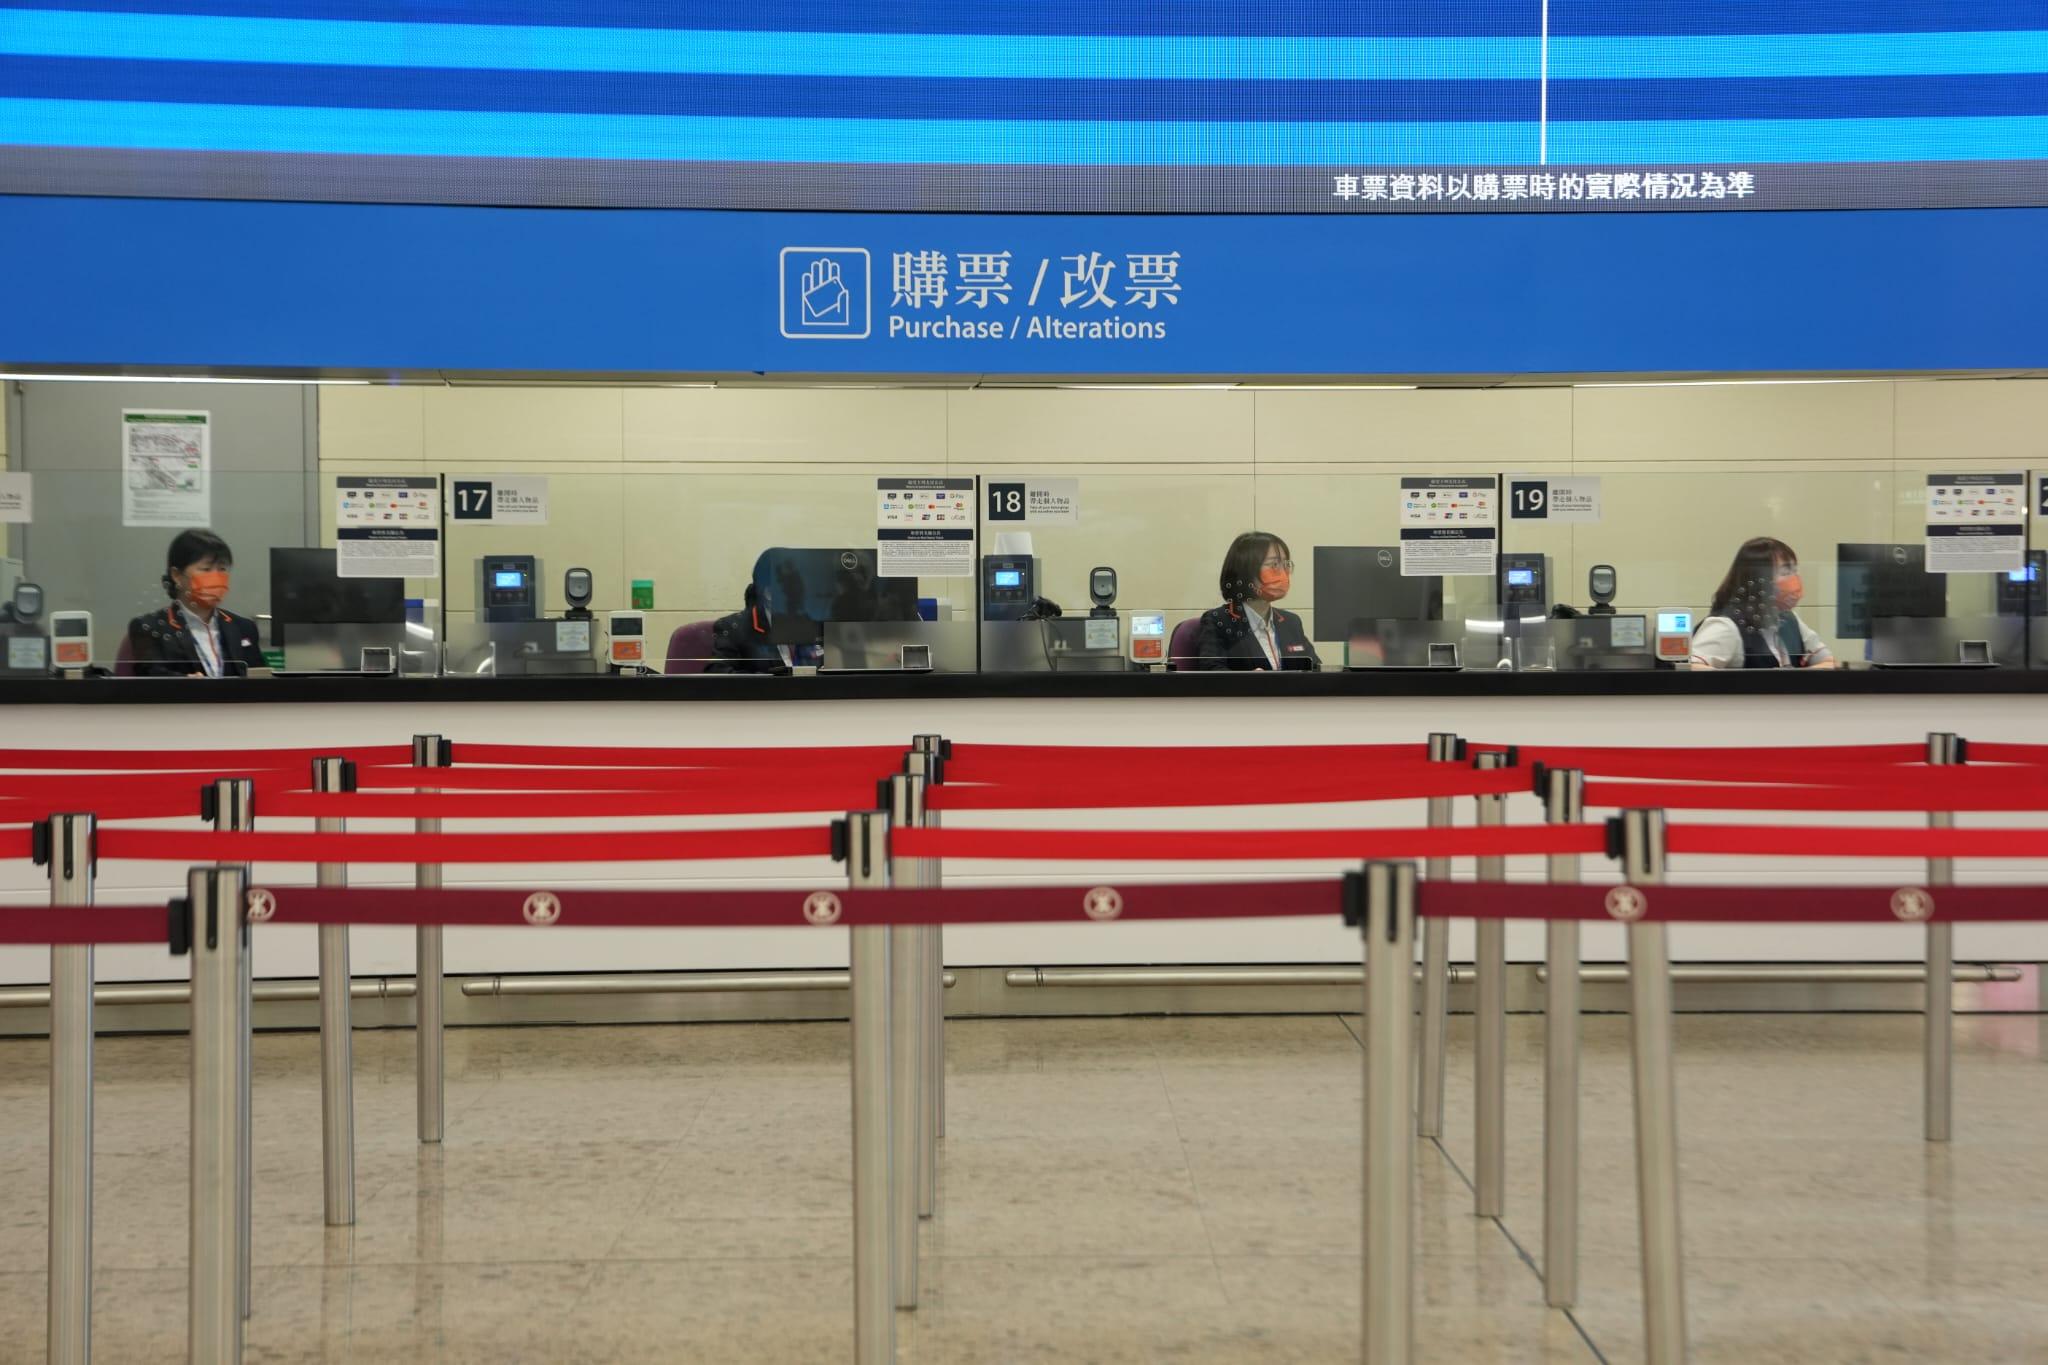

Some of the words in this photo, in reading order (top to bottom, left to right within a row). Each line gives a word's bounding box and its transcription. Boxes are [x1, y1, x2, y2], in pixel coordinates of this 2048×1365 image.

[1333, 171, 1755, 203] 車票資料以購票時的實際情況為準
[889, 314, 1004, 339] Purchase
[1026, 315, 1166, 339] Alterations
[458, 489, 488, 512] 17
[992, 490, 1021, 513] 18
[1515, 489, 1544, 511] 19
